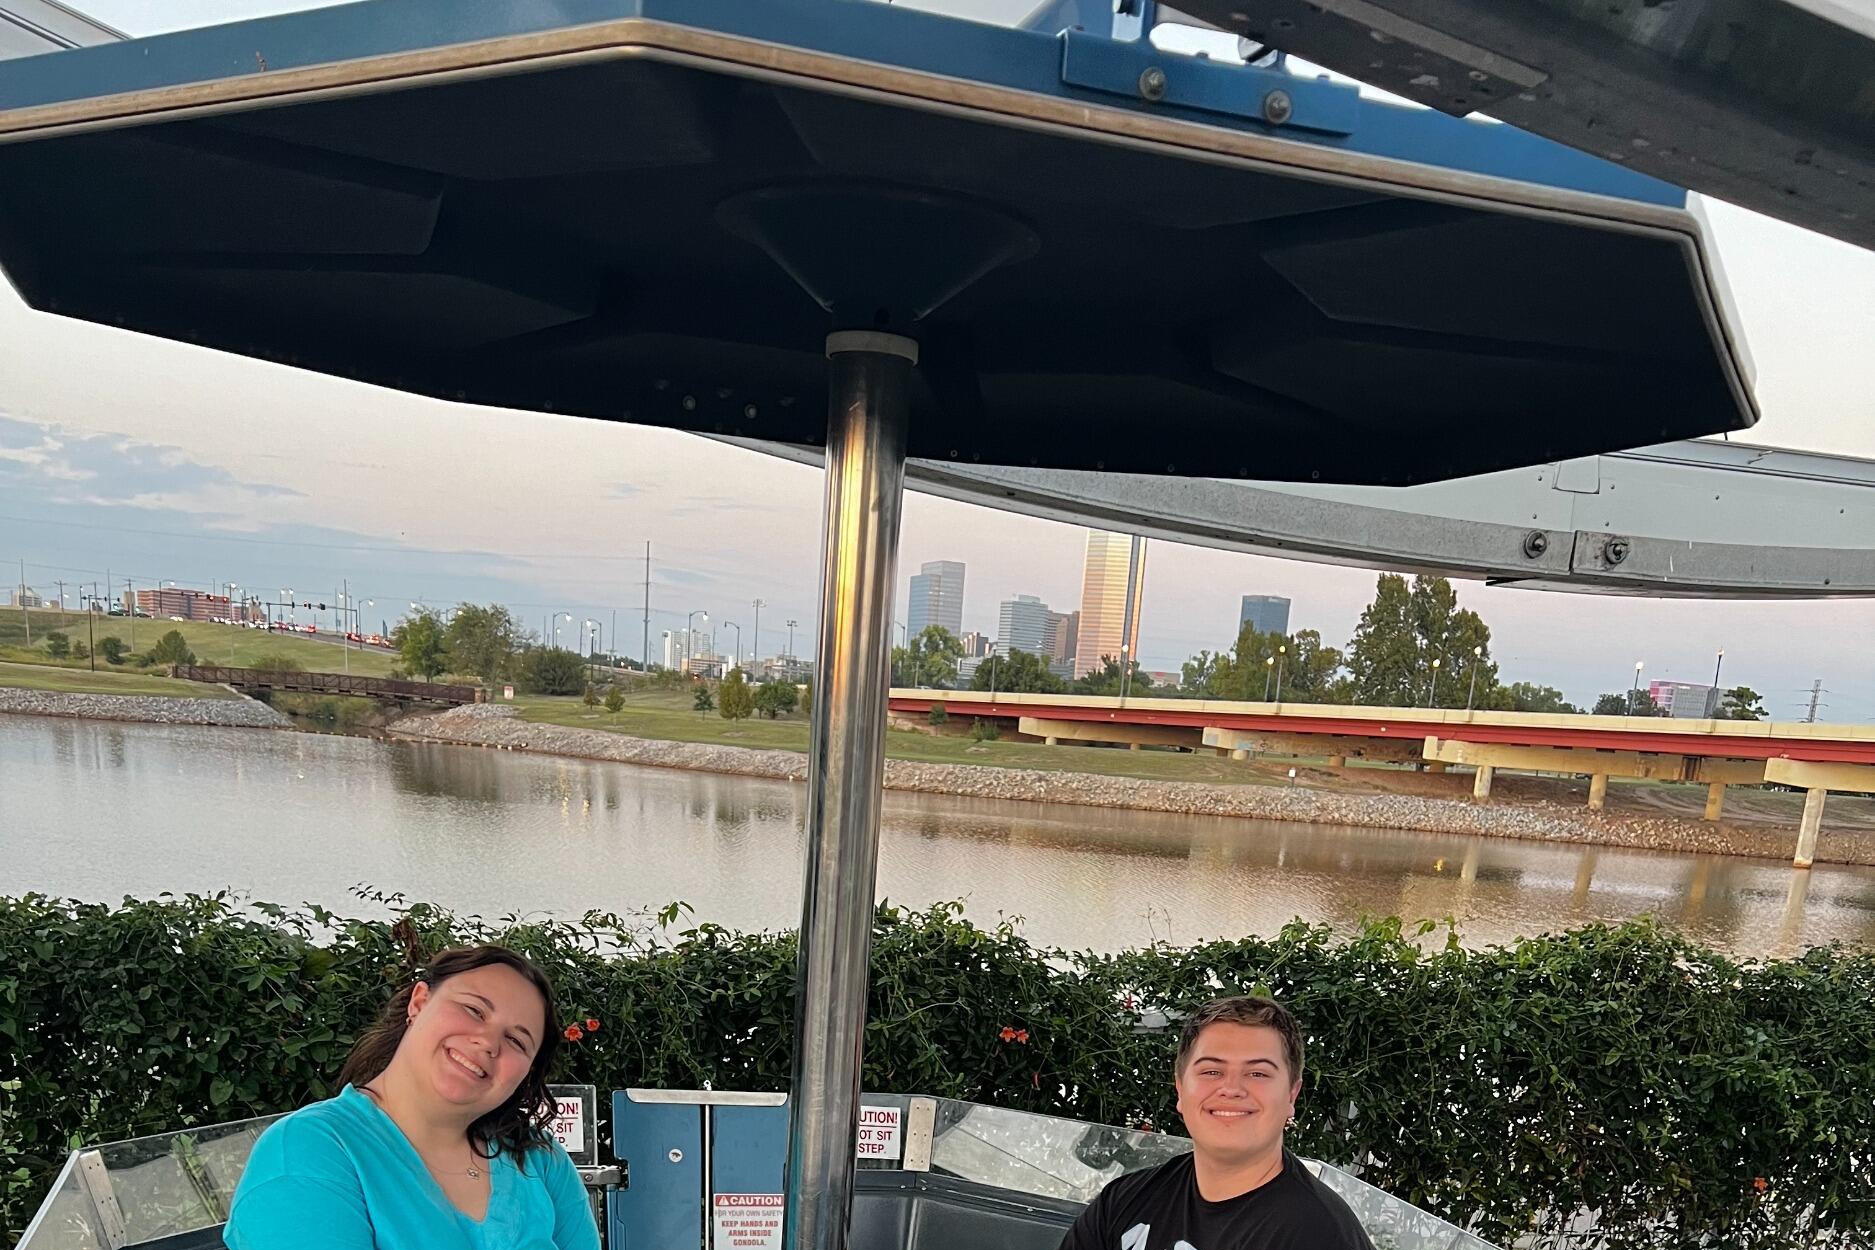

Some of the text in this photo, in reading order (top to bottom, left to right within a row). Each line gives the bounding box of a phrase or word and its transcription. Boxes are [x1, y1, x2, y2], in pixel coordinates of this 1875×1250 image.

[860, 1111, 897, 1124] UTION!
[556, 1123, 573, 1133] SIT
[860, 1130, 892, 1140] OT SIT
[859, 1143, 886, 1154] STEP.
[730, 1197, 781, 1205] CAUTION
